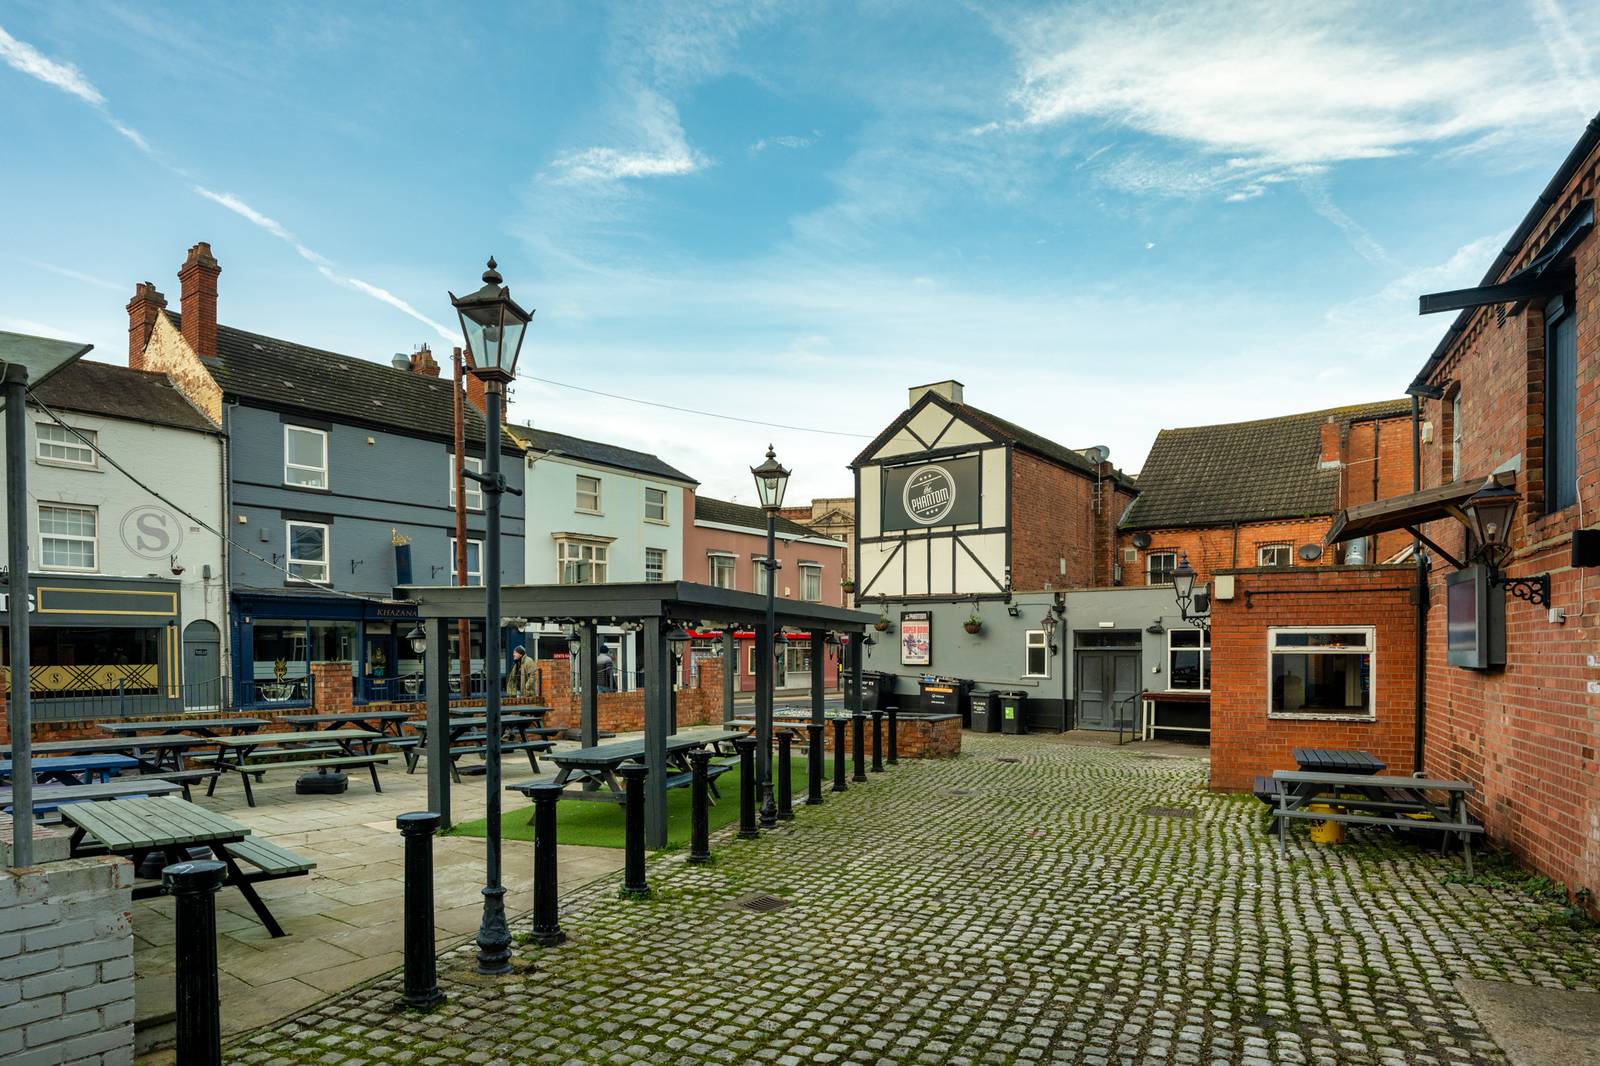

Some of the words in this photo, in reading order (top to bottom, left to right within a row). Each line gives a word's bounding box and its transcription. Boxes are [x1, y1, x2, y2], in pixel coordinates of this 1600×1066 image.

[911, 488, 949, 511] PHANTOM
[136, 513, 169, 551] S
[376, 609, 417, 617] KHAZANA
